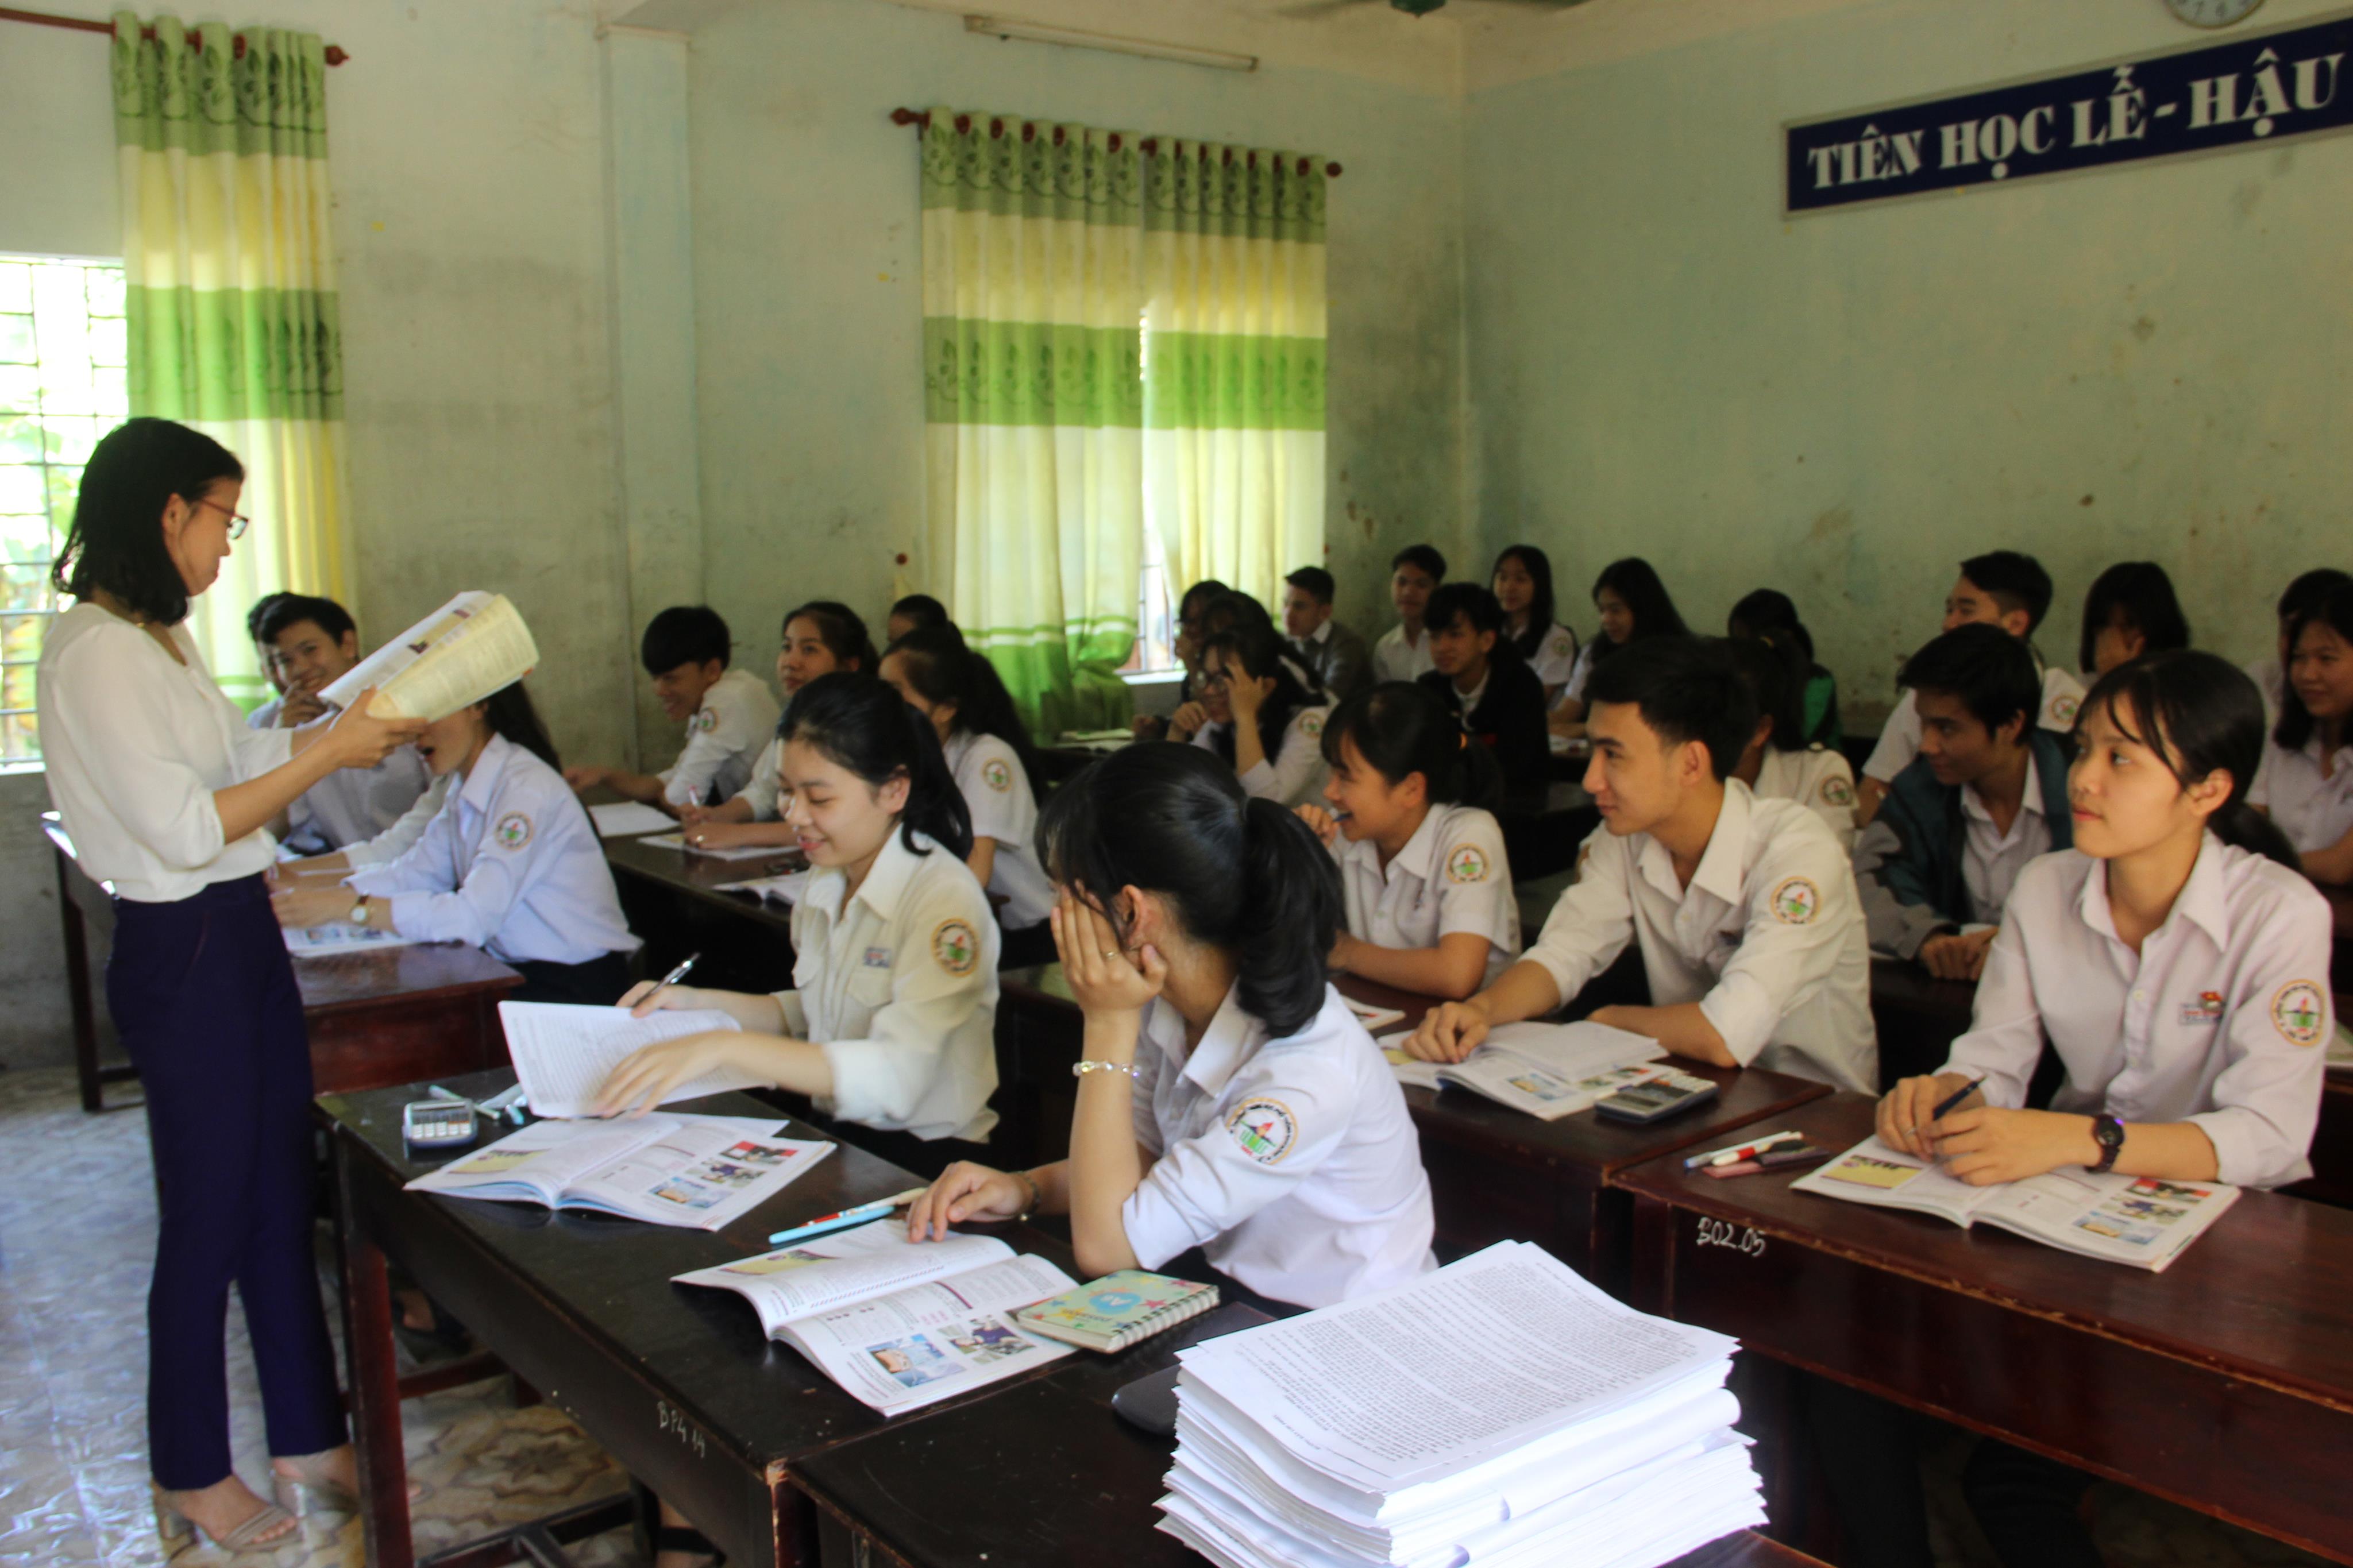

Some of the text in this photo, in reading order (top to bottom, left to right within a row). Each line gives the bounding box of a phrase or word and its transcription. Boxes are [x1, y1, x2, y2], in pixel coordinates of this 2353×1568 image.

[1808, 124, 1923, 188] TIÊN
[1939, 105, 2054, 180] HỌC
[2071, 64, 2146, 148] LỄ
[2188, 48, 2344, 137] HẬU
[1696, 1216, 1768, 1257] B02.05
